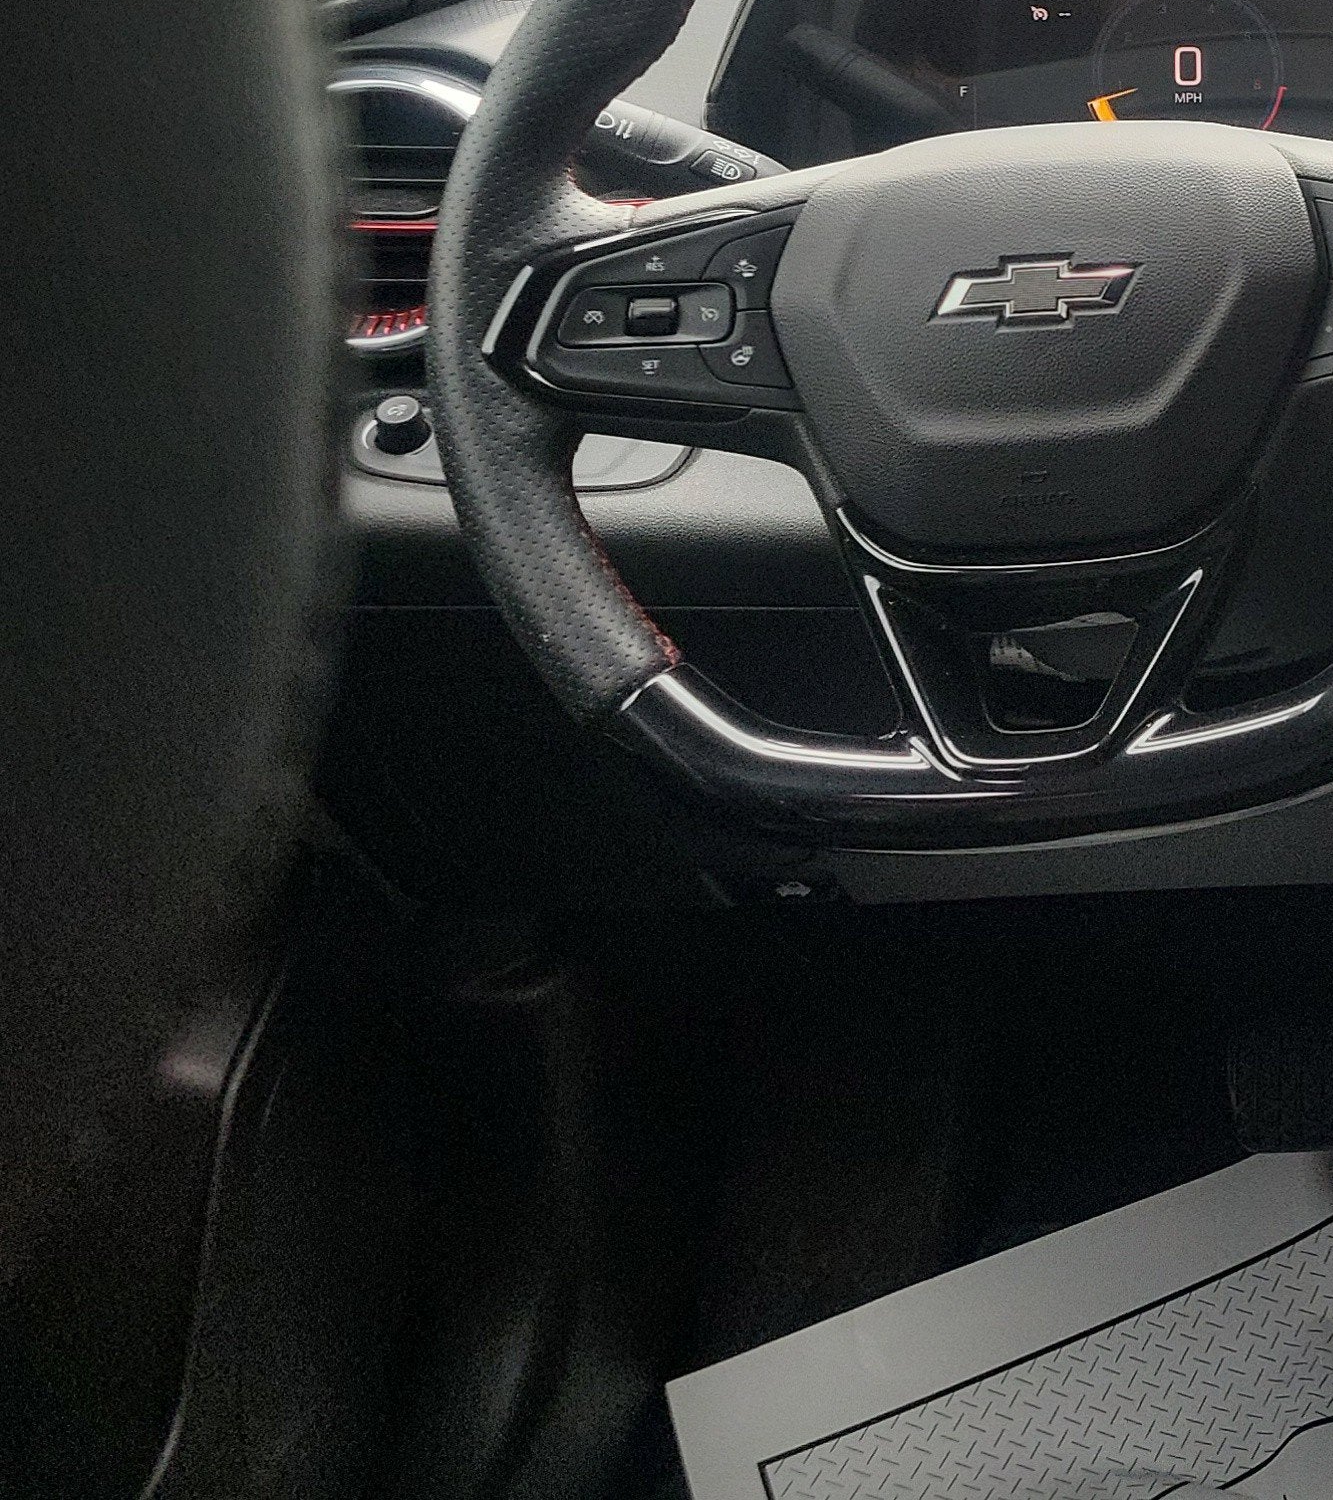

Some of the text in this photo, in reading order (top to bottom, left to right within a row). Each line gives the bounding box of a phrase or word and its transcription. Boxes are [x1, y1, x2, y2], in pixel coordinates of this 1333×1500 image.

[1174, 45, 1202, 87] 0
[959, 85, 968, 98] F
[1174, 92, 1203, 104] MPH
